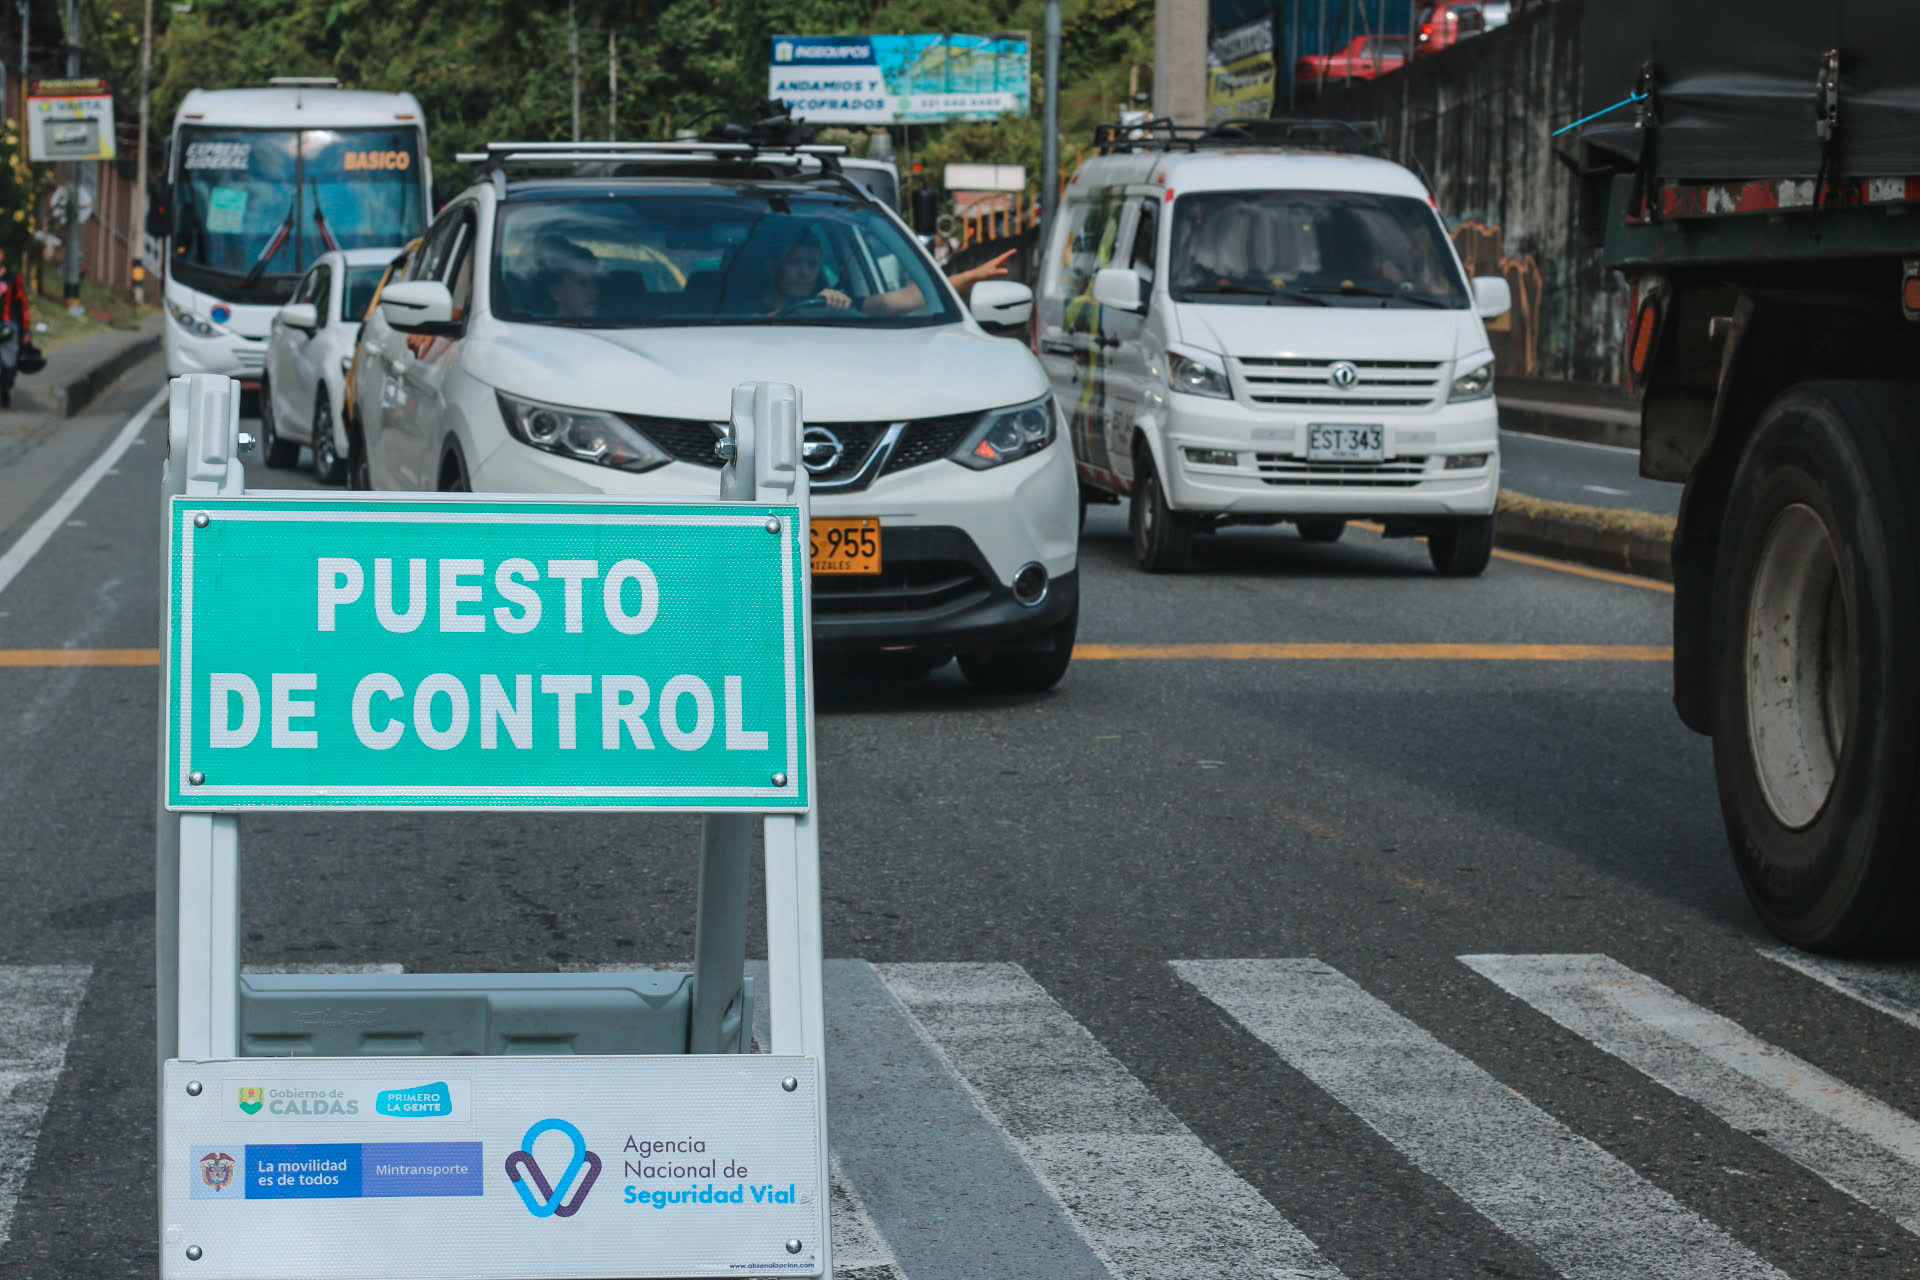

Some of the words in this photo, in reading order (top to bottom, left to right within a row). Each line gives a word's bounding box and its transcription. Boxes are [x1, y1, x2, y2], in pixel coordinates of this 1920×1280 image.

[776, 81, 863, 90] ANDAMIOS
[869, 81, 878, 90] Y
[785, 99, 885, 109] NCOFRADOS
[344, 151, 410, 171] BASICO
[827, 527, 876, 558] 955
[317, 557, 660, 635] PUESTO
[210, 672, 318, 749] DE
[351, 672, 769, 751] CONTROL
[269, 1088, 327, 1098] Gobierno
[329, 1088, 344, 1098] de
[388, 1093, 440, 1103] PRIMERO
[269, 1100, 359, 1115] CALDAS
[387, 1103, 402, 1112] LA
[403, 1103, 441, 1112] GENTE
[623, 1134, 706, 1158] Agencia
[258, 1160, 274, 1173] La
[278, 1159, 347, 1172] movilidad
[376, 1164, 468, 1177] Mintransporte
[624, 1159, 716, 1178] Nacional
[723, 1159, 748, 1178] de
[258, 1176, 274, 1186] es
[277, 1174, 295, 1186] de
[299, 1174, 339, 1186] todos
[624, 1183, 744, 1209] Seguridad
[750, 1183, 795, 1204] Vial
